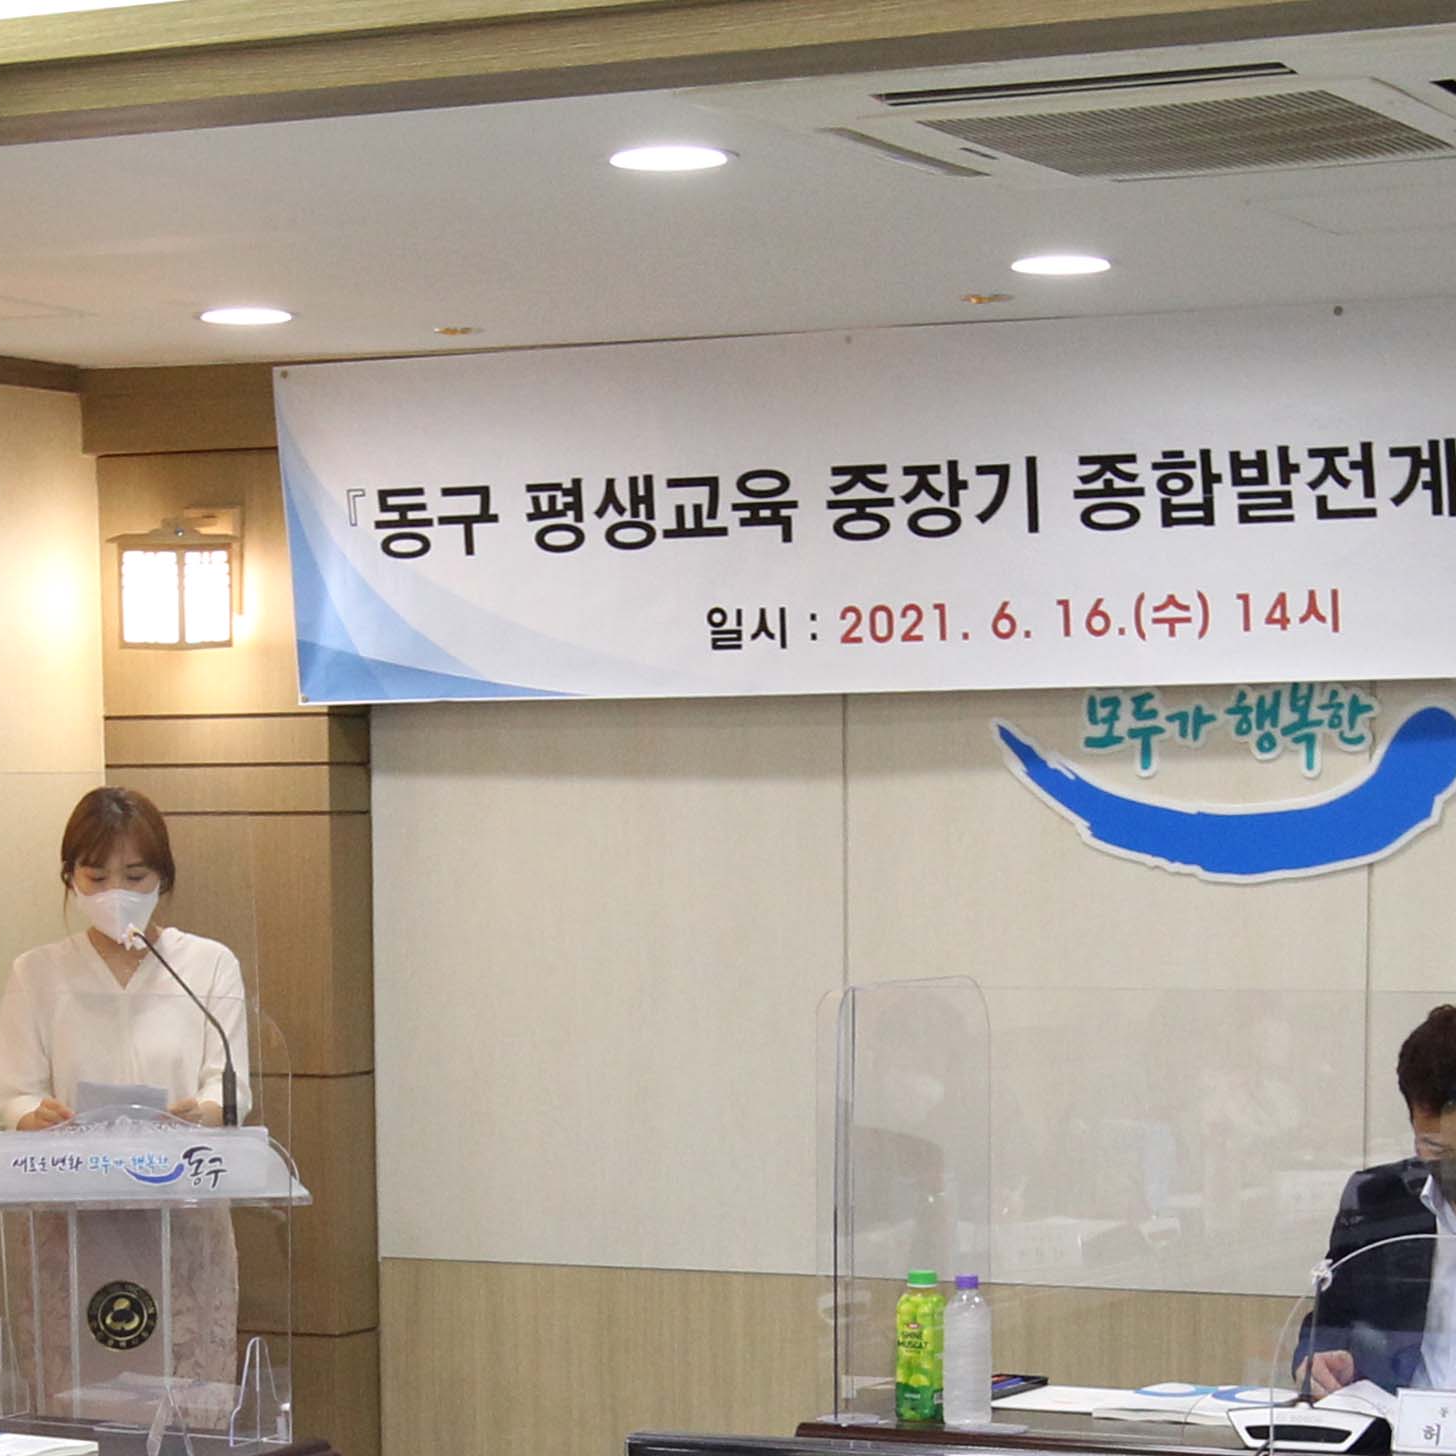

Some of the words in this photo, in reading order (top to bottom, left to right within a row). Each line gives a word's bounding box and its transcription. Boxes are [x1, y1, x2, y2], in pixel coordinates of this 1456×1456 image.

[524, 467, 800, 555] 평생교육
[825, 452, 1042, 543] 중장기
[705, 602, 789, 652] 일시
[838, 601, 971, 646] 2021.
[990, 601, 1033, 642] 6.
[1055, 589, 1212, 643] 16.(수)
[1235, 585, 1343, 638] 14시
[1084, 691, 1218, 772] 모두가
[1224, 681, 1376, 772] 행복한
[182, 1145, 227, 1189] 동구
